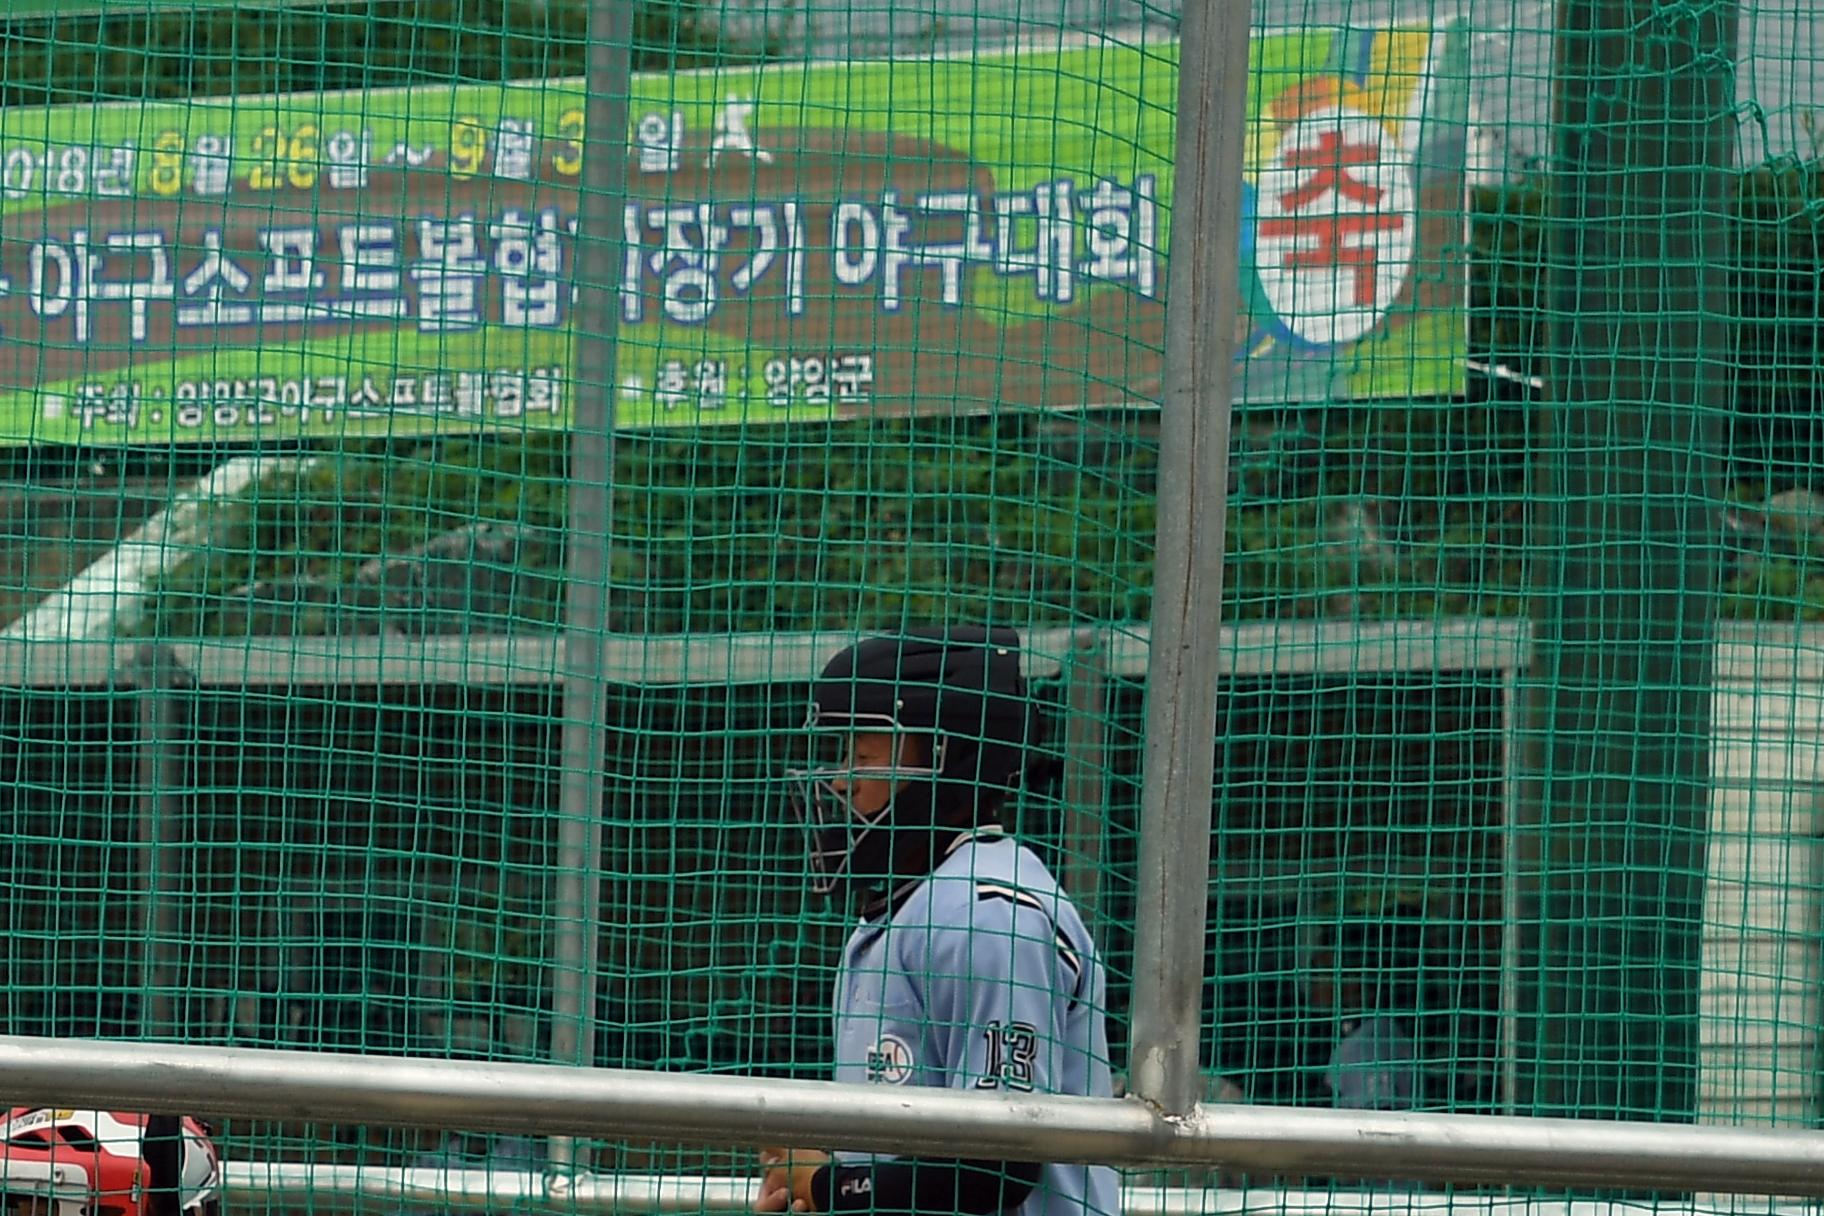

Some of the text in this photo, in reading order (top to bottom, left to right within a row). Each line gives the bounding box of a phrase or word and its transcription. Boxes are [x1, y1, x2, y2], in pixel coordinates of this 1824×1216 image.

[26, 200, 805, 344] 야구소프트볼협장기
[828, 173, 1157, 312] 야구대회
[1258, 130, 1405, 306] 축
[763, 354, 873, 405] 양양군
[975, 1020, 1040, 1093] 13
